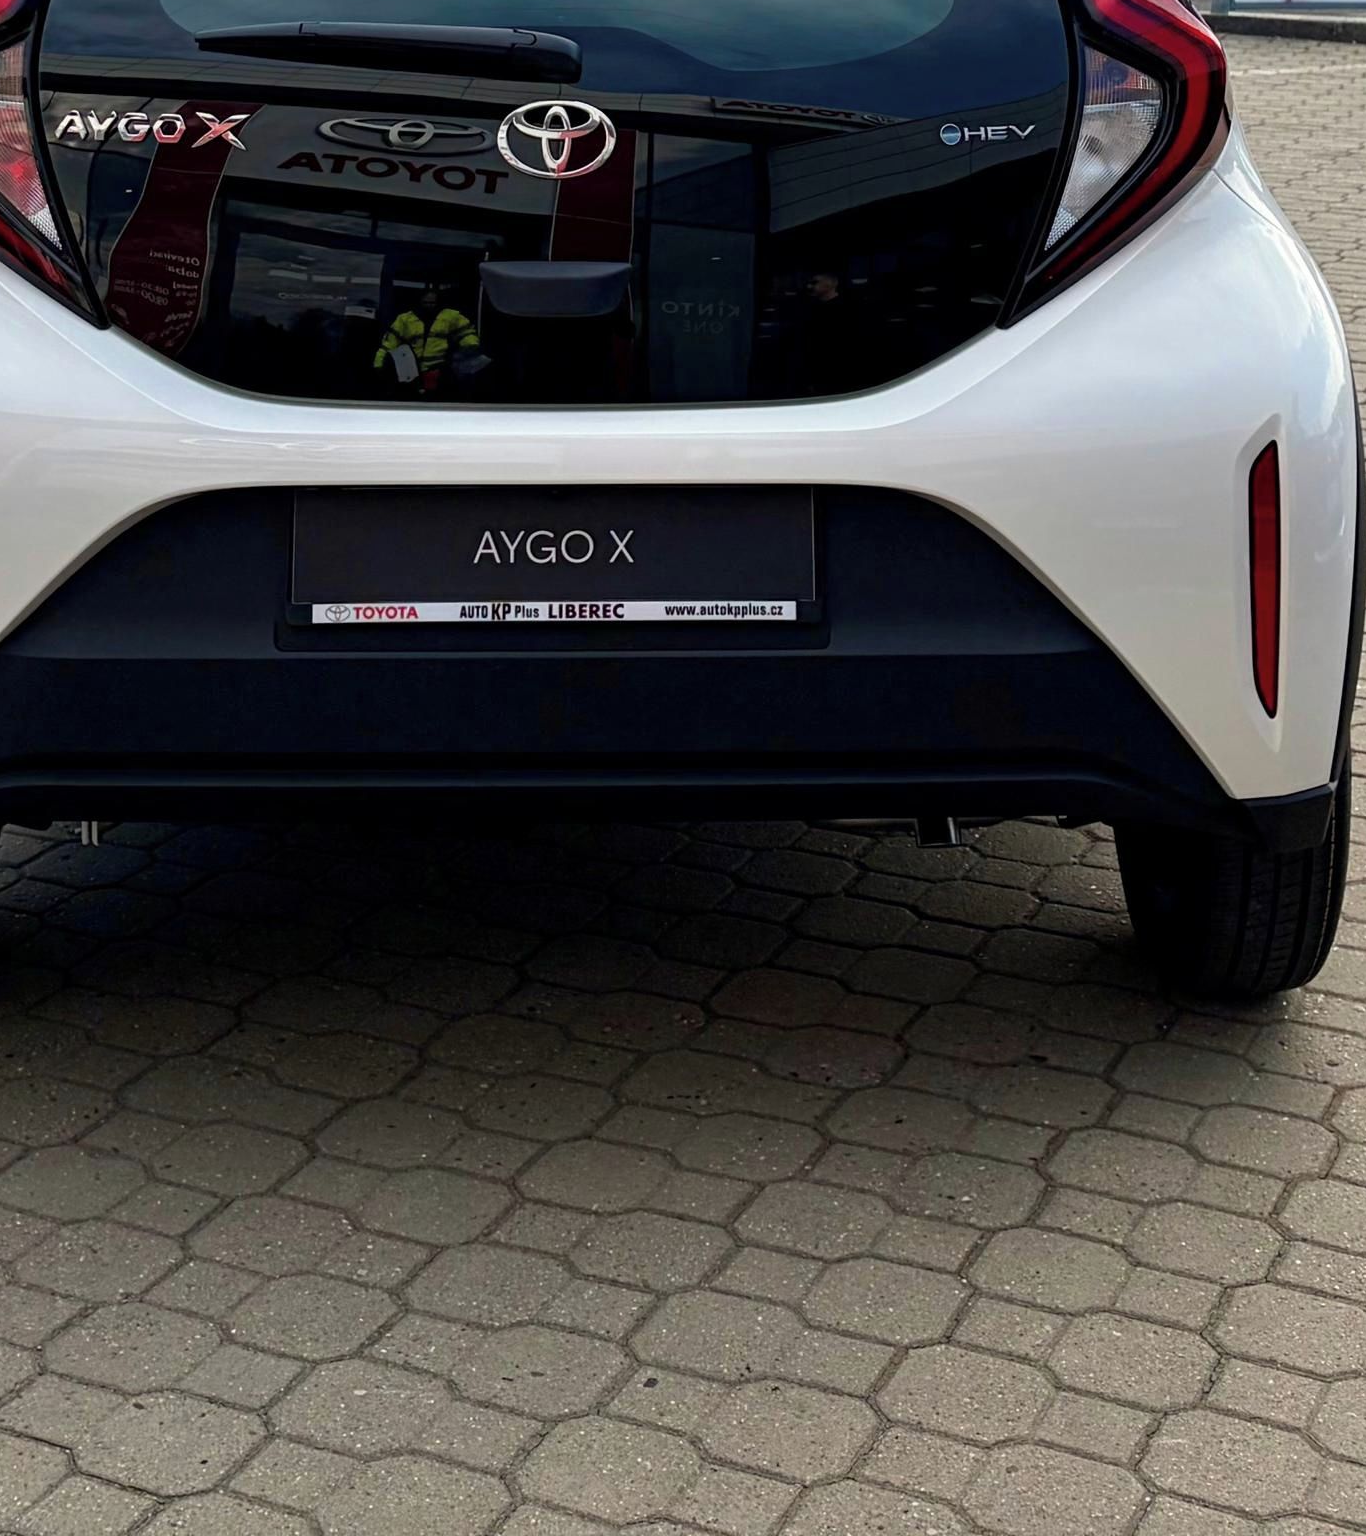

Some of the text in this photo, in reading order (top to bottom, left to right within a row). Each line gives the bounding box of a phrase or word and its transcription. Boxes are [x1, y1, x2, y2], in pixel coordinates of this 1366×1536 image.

[54, 109, 252, 152] AYGO X
[963, 124, 1036, 142] HEV
[473, 529, 635, 565] AYGO X
[353, 602, 784, 621] TOYOTA AUTO KP Plus LIBEREC www.autokpplus.cz
